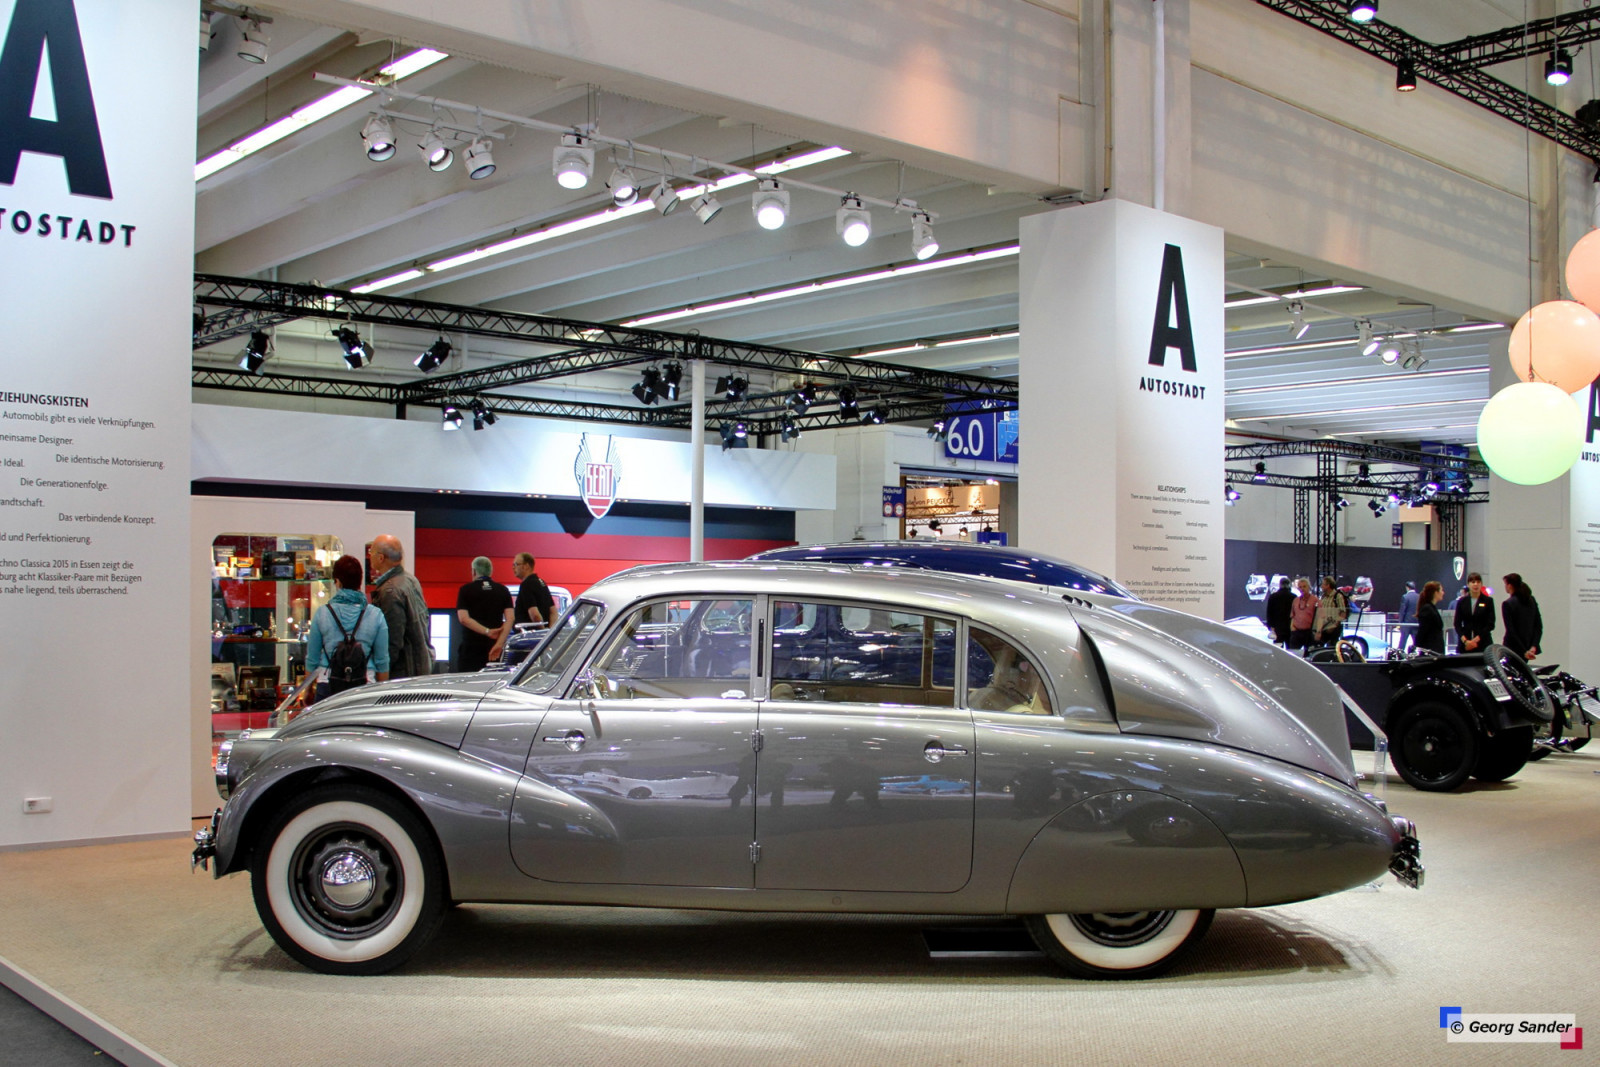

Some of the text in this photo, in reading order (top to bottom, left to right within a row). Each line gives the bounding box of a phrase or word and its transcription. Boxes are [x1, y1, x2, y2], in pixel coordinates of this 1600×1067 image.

[0, 0, 113, 200] A
[1148, 243, 1197, 373] A
[1139, 376, 1205, 400] AUTOSTADT
[3, 411, 48, 422] Automobils
[50, 413, 65, 425] gibt
[78, 416, 96, 425] viele
[39, 434, 74, 446] Designer.
[948, 416, 984, 457] 6.0
[56, 453, 69, 463] Die
[71, 455, 110, 466] identische
[20, 477, 34, 487] Die
[587, 464, 612, 497] SEAT
[59, 513, 73, 522] Das
[75, 513, 122, 523] verbindende
[8, 532, 24, 542] und
[20, 558, 51, 568] Classica
[52, 559, 69, 569] 2015
[71, 560, 78, 569] in
[80, 560, 100, 569] Essen
[102, 560, 121, 571] zeigt
[122, 561, 134, 570] die
[18, 572, 36, 581] acht
[38, 572, 94, 583] Klassiker-Paare
[96, 573, 109, 582] mit
[111, 573, 142, 585] Bezügen
[4, 585, 24, 594] nahe
[58, 586, 75, 595] teils
